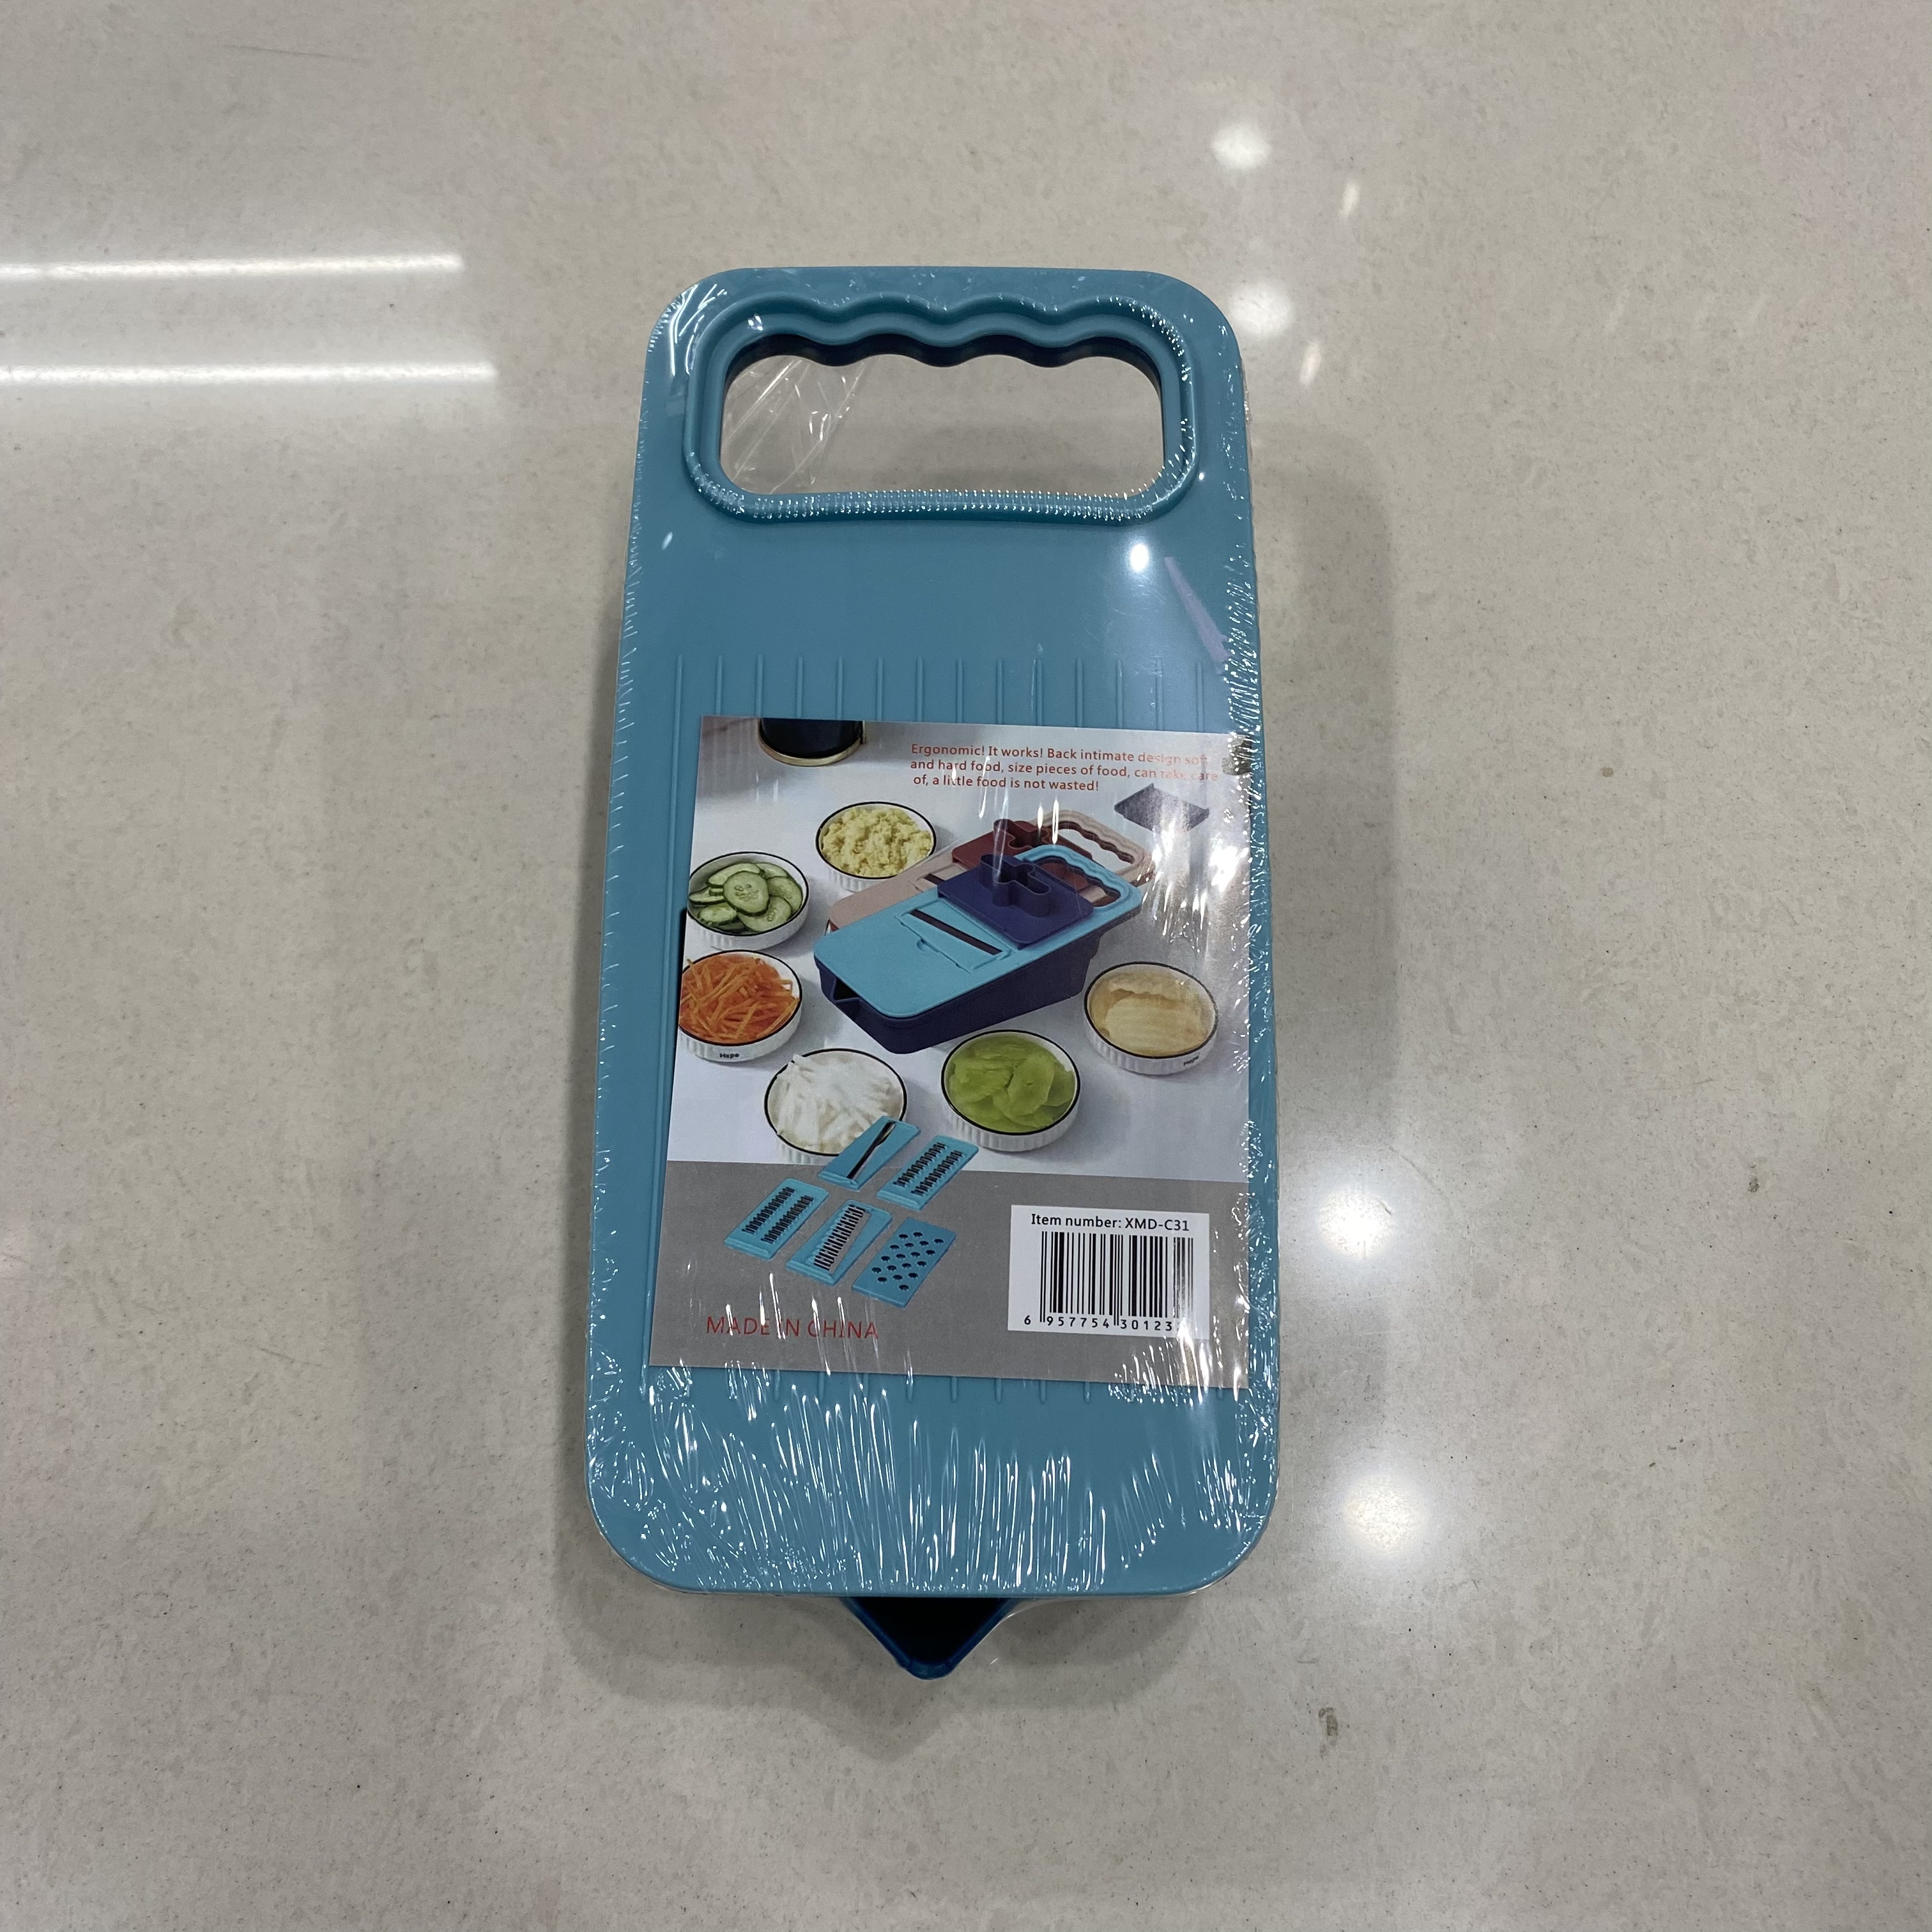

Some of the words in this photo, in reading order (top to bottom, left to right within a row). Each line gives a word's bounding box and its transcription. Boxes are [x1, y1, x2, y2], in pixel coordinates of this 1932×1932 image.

[912, 744, 985, 756] Ergonomic!
[988, 746, 998, 756] It
[1001, 746, 1043, 758] works!
[1047, 747, 1077, 759] Back
[1080, 749, 1134, 762] intimate
[1138, 752, 1181, 766] design
[910, 759, 934, 769] and
[939, 760, 967, 770] hard
[971, 760, 1004, 773] food,
[1008, 762, 1032, 772] size
[1036, 763, 1077, 776] pieces
[1080, 765, 1094, 775] of
[1097, 765, 1130, 778] food,
[1135, 769, 1156, 778] can
[1191, 772, 1218, 781] care
[914, 774, 928, 786] of,
[932, 777, 939, 785] a
[944, 774, 973, 786] little
[977, 776, 1006, 788] food
[1010, 777, 1020, 788] is
[1023, 779, 1046, 790] not
[1048, 780, 1099, 792] wasted!
[1031, 1214, 1061, 1226] Item
[1065, 1216, 1122, 1229] number:
[1124, 1218, 1190, 1232] XMD-C31
[707, 1316, 770, 1336] MADE
[808, 1320, 878, 1340] CHINA
[1023, 1315, 1031, 1326] 6
[1046, 1316, 1110, 1328] 957754
[1120, 1319, 1184, 1332] 30123
